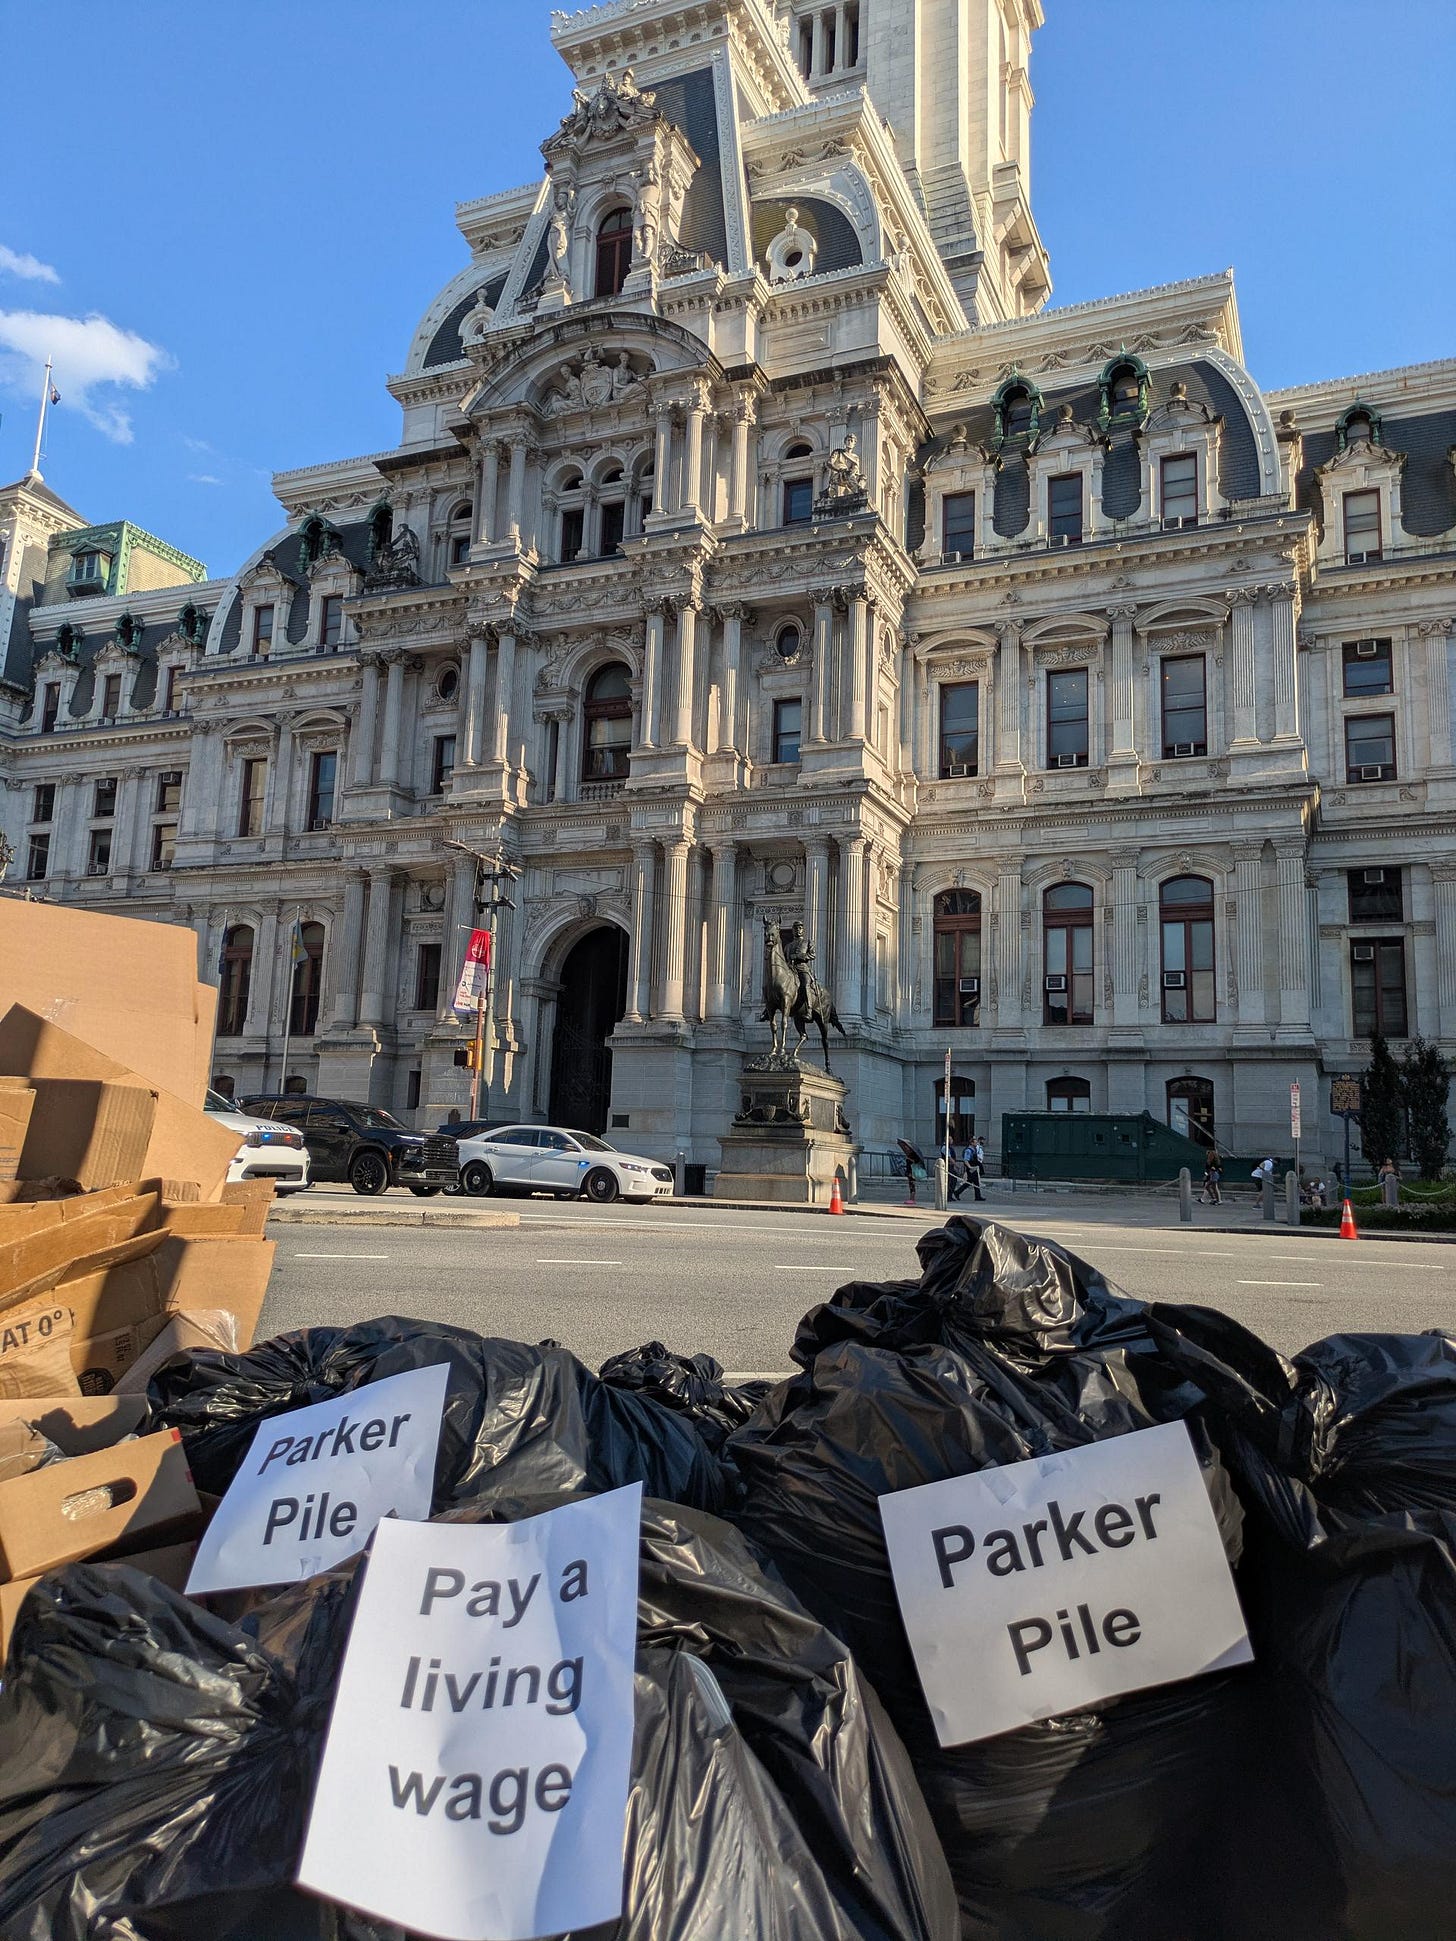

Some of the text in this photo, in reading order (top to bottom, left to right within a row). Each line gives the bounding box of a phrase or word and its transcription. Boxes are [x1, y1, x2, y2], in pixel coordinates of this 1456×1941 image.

[255, 1125, 296, 1133] POLICE
[2, 1321, 31, 1354] AT
[257, 1412, 412, 1476] Parker
[262, 1491, 358, 1546] Pile
[931, 1493, 1161, 1589] Parker
[419, 1558, 589, 1629] Pay a
[1007, 1603, 1142, 1676] Pile
[400, 1655, 584, 1716] living
[388, 1761, 573, 1836] wage
